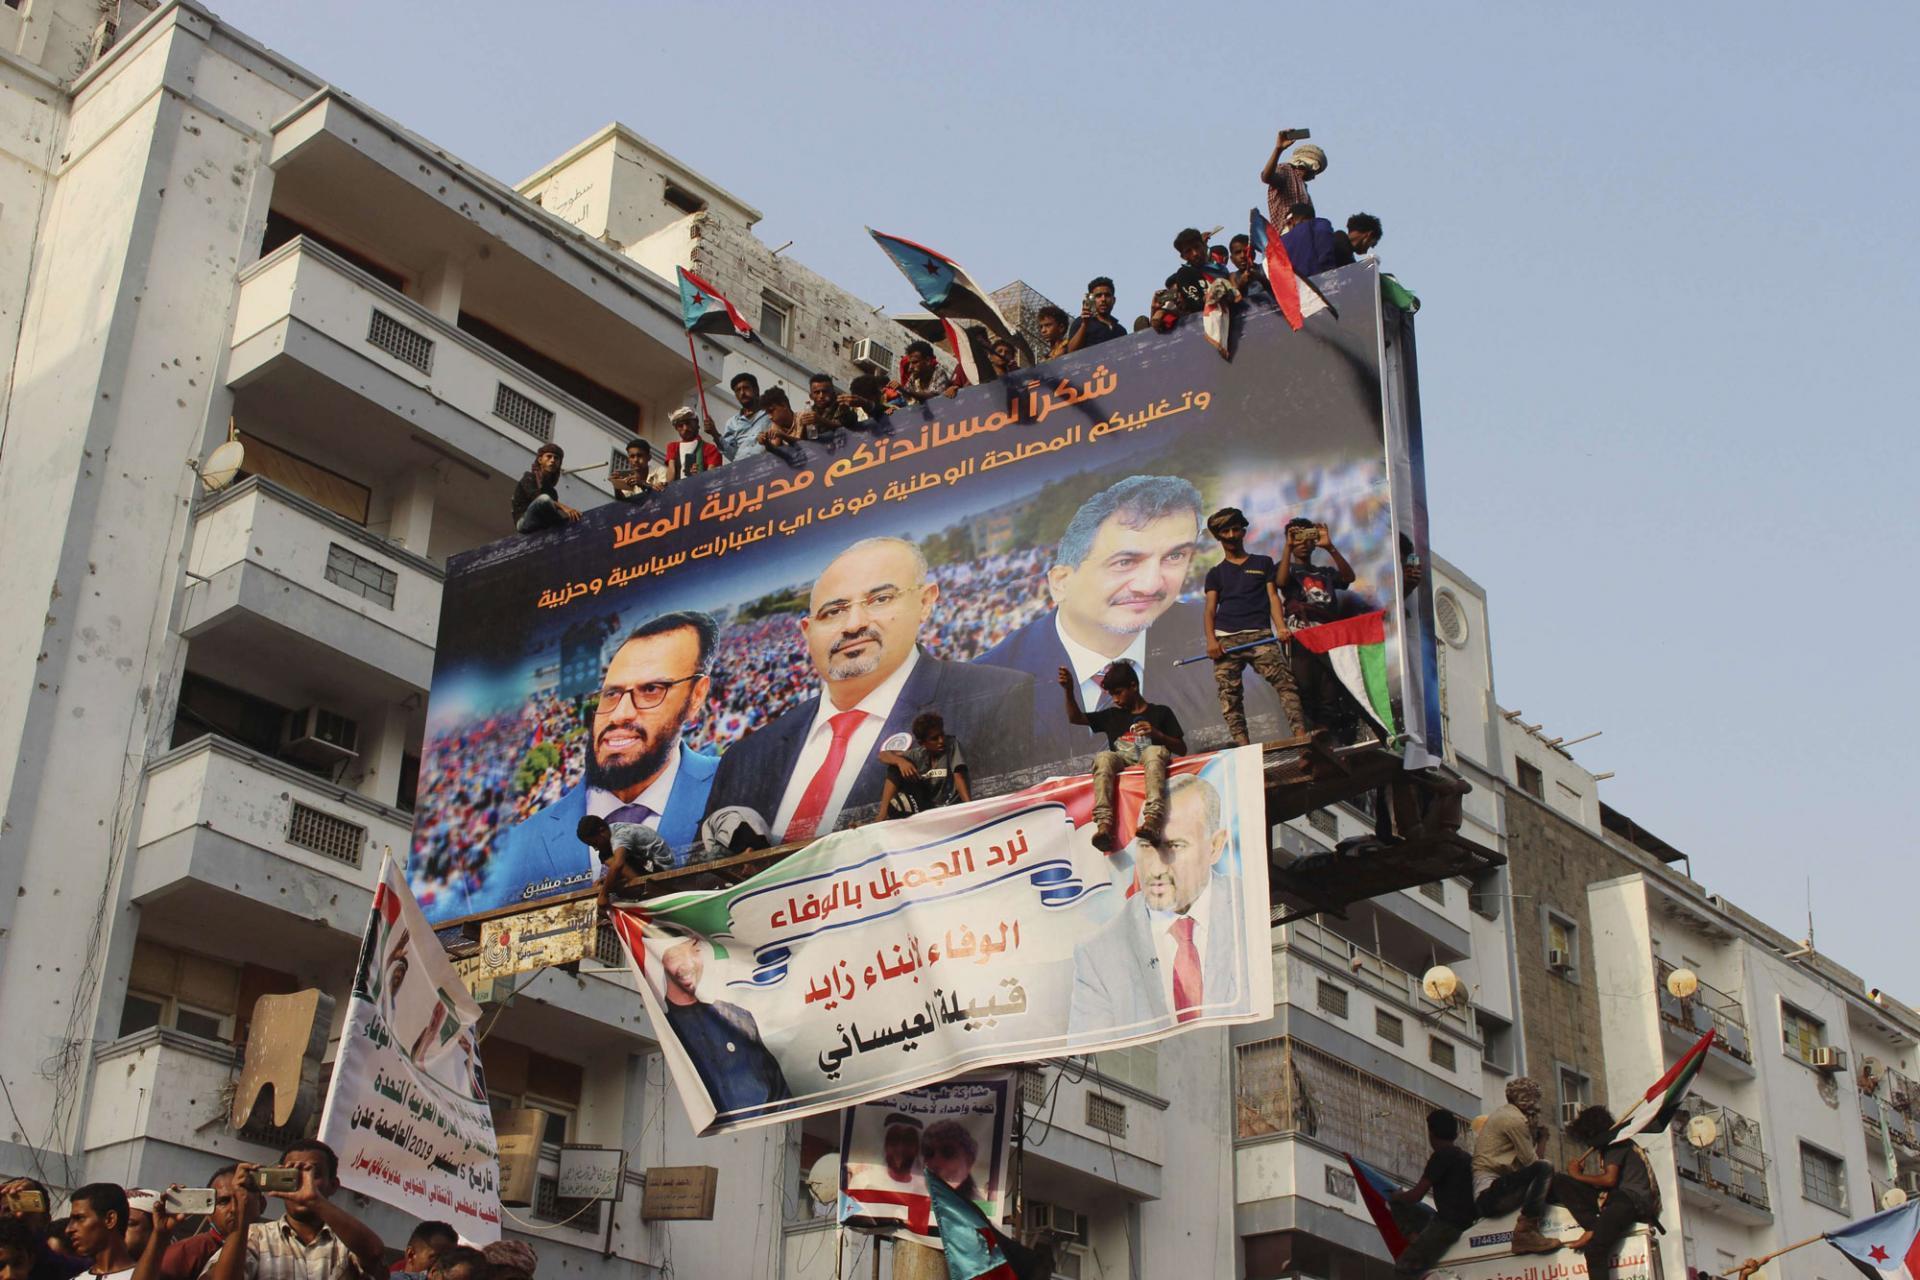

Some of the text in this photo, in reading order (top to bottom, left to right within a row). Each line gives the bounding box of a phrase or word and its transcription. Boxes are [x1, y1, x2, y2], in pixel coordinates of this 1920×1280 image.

[612, 364, 1118, 549] شكراً لمساندتكم مديرية المعلا
[536, 390, 1212, 609] وتغليبكم المصلحة الوطنية فوق اي اعتبارات سياسية وحزبية
[770, 828, 1029, 929] نرد الجميل بالوفاء
[927, 918, 1021, 968] الوفاء
[803, 958, 856, 1011] زايد
[818, 976, 1028, 1081] قبيلة العيسائي
[373, 1067, 412, 1106] المتحدة
[408, 1084, 438, 1122] العربية
[351, 1104, 375, 1130] عدن
[374, 1108, 413, 1151] العاصمة
[407, 1136, 434, 1161] 2019
[427, 1151, 461, 1178] سبتمبر
[459, 1163, 466, 1180] 5
